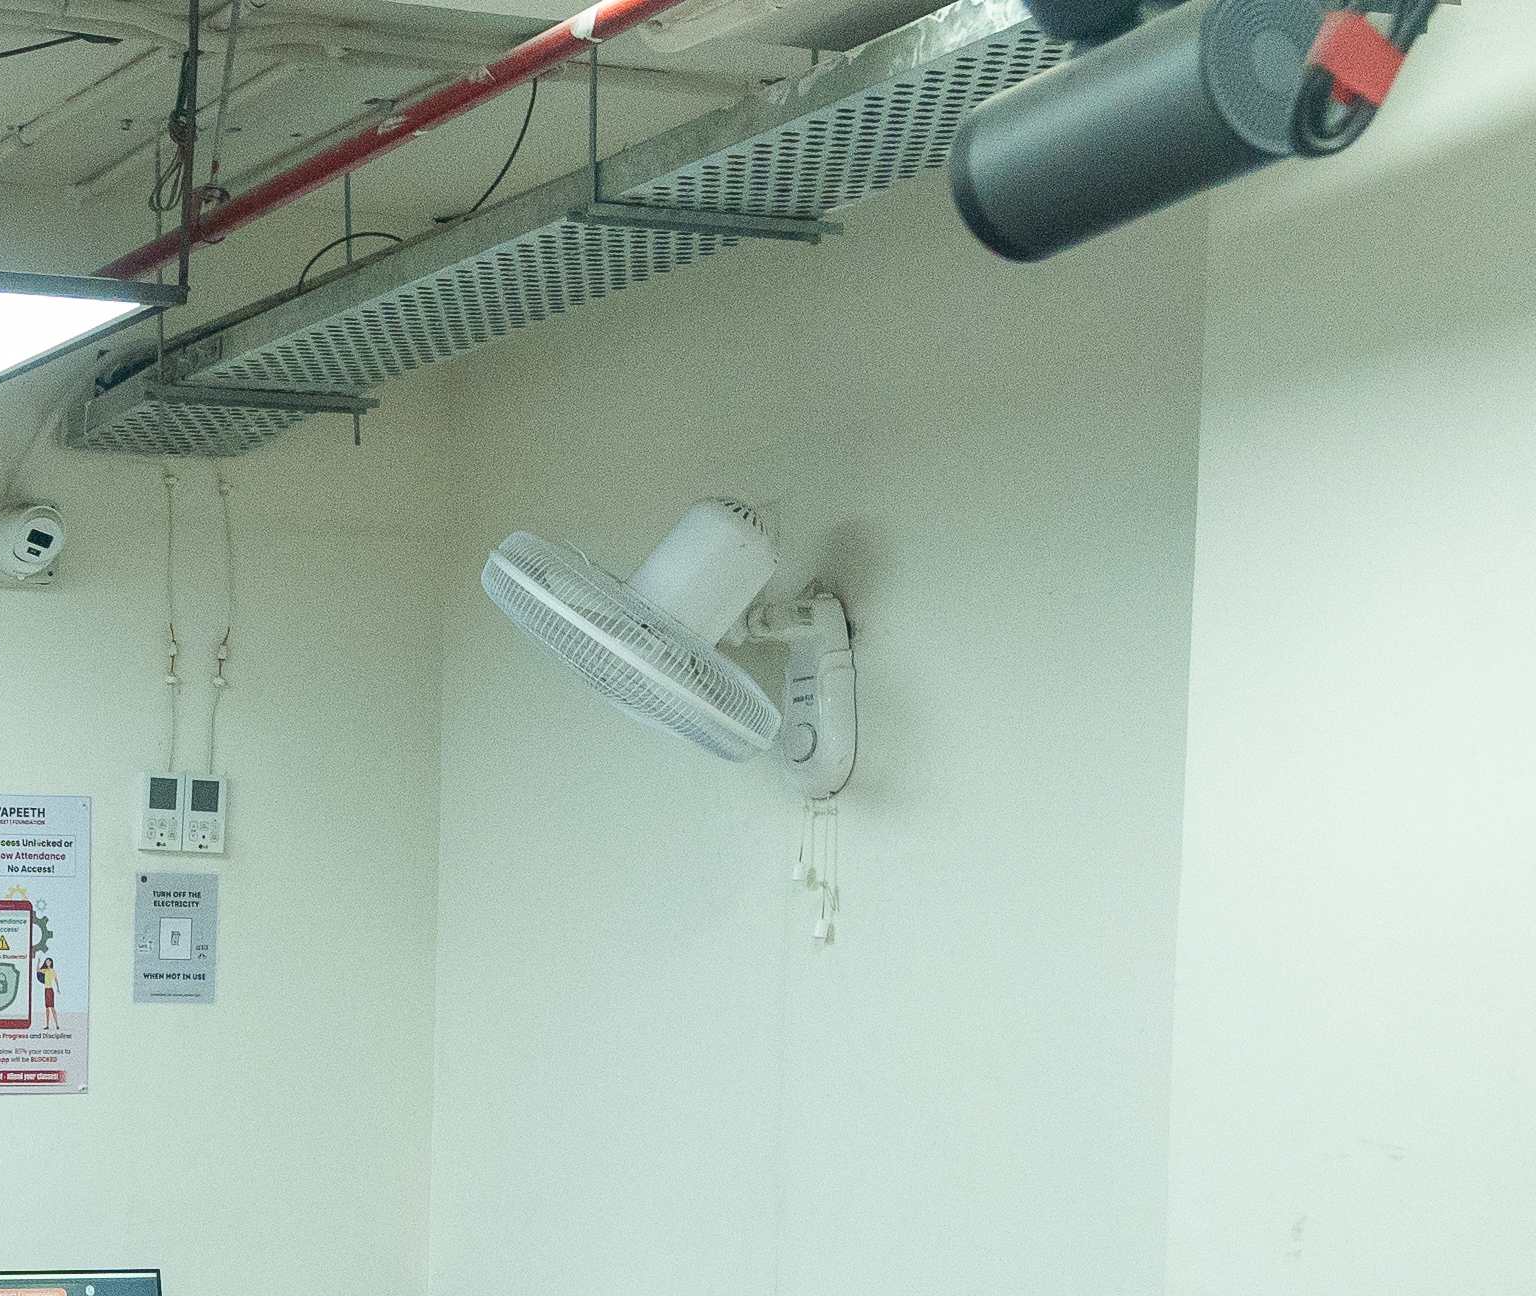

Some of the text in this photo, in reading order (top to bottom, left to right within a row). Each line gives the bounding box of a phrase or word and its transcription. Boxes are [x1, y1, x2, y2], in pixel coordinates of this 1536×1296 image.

[22, 838, 63, 848] Unlocked
[64, 840, 73, 848] or
[14, 852, 66, 861] Attendance
[7, 864, 55, 874] No Access!
[152, 890, 202, 899] TURN OFF THE
[153, 900, 200, 908] ELECTRICITY
[143, 972, 206, 981] WHEN NOT IN USE
